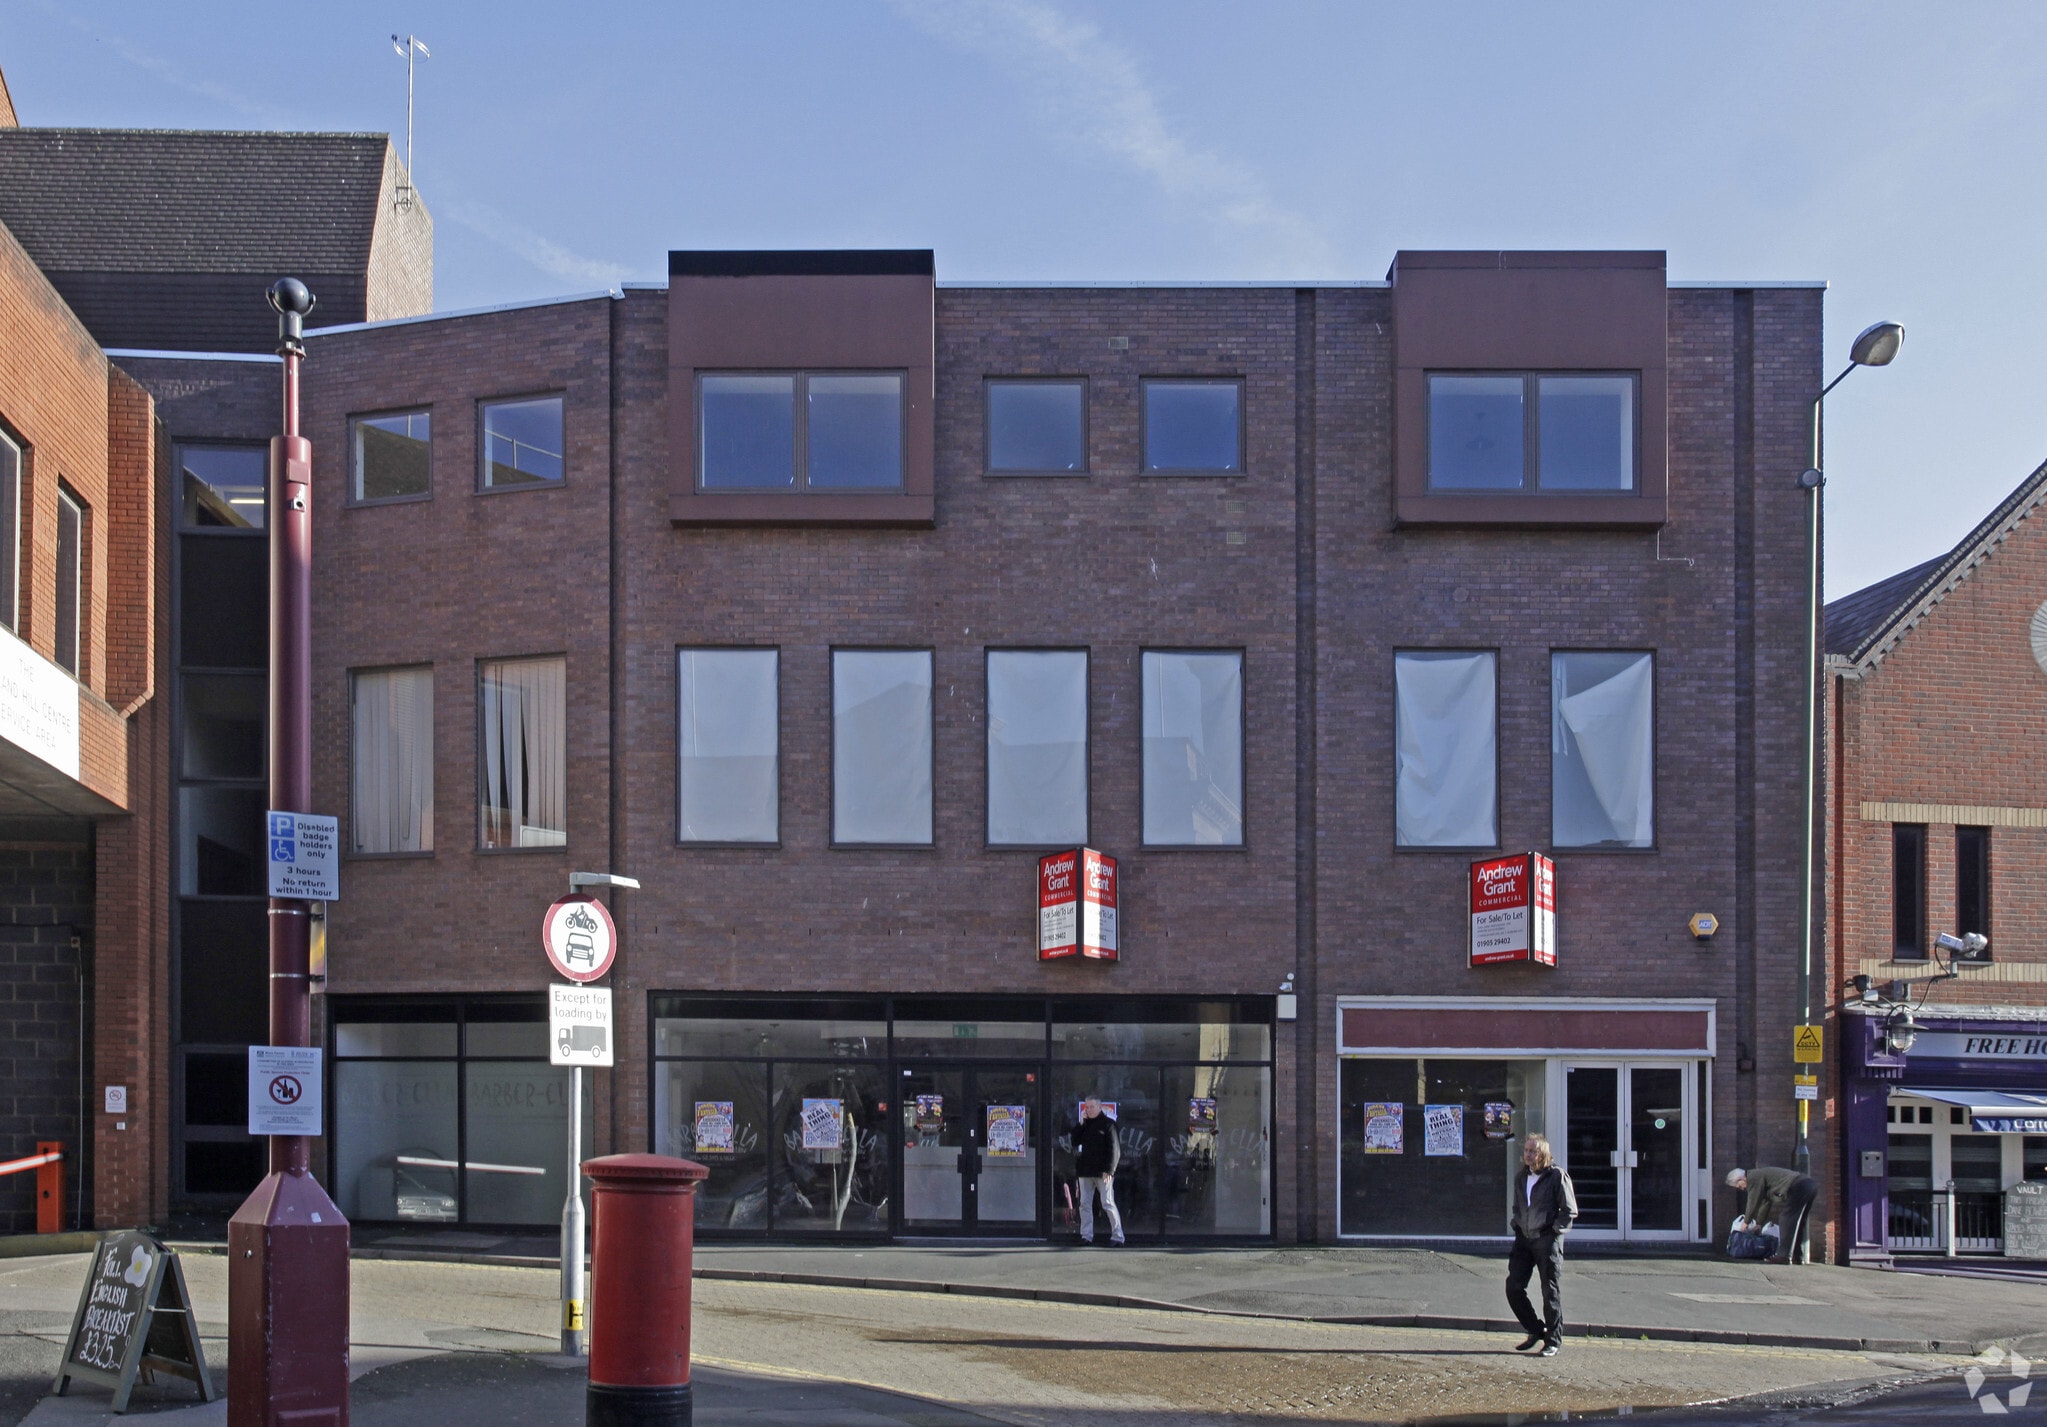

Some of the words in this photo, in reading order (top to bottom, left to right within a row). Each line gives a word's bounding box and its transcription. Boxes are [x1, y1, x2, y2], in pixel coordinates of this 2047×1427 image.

[0, 675, 18, 698] AND
[42, 702, 70, 734] CENTRE
[36, 726, 56, 748] AREA
[298, 823, 334, 833] Disabled
[303, 832, 329, 841] badge
[300, 841, 332, 850] holders
[307, 850, 325, 859] only
[296, 867, 321, 876] hours
[1044, 860, 1074, 877] Andrew
[1086, 856, 1114, 877] Andrew
[1477, 864, 1523, 882] Andrew
[298, 879, 326, 887] return
[1048, 874, 1069, 890] Grant
[1090, 872, 1109, 891] Grant
[1483, 879, 1516, 896] Grant
[1044, 890, 1074, 901] COMMERCIAL
[1479, 894, 1522, 906] COMMERCIAL
[1513, 912, 1523, 920] Let
[1494, 937, 1511, 946] 29402
[555, 991, 590, 1005] Except
[593, 994, 607, 1005] for
[555, 1006, 592, 1021] loading
[596, 1010, 607, 1022] by
[1964, 1038, 2021, 1054] FREE
[807, 1108, 825, 1120] REAL
[808, 1112, 830, 1127] THING
[1430, 1113, 1448, 1123] REAL
[1429, 1118, 1453, 1130] THING
[2016, 1186, 2044, 1194] VAULT
[90, 1278, 128, 1308] ENGLISH
